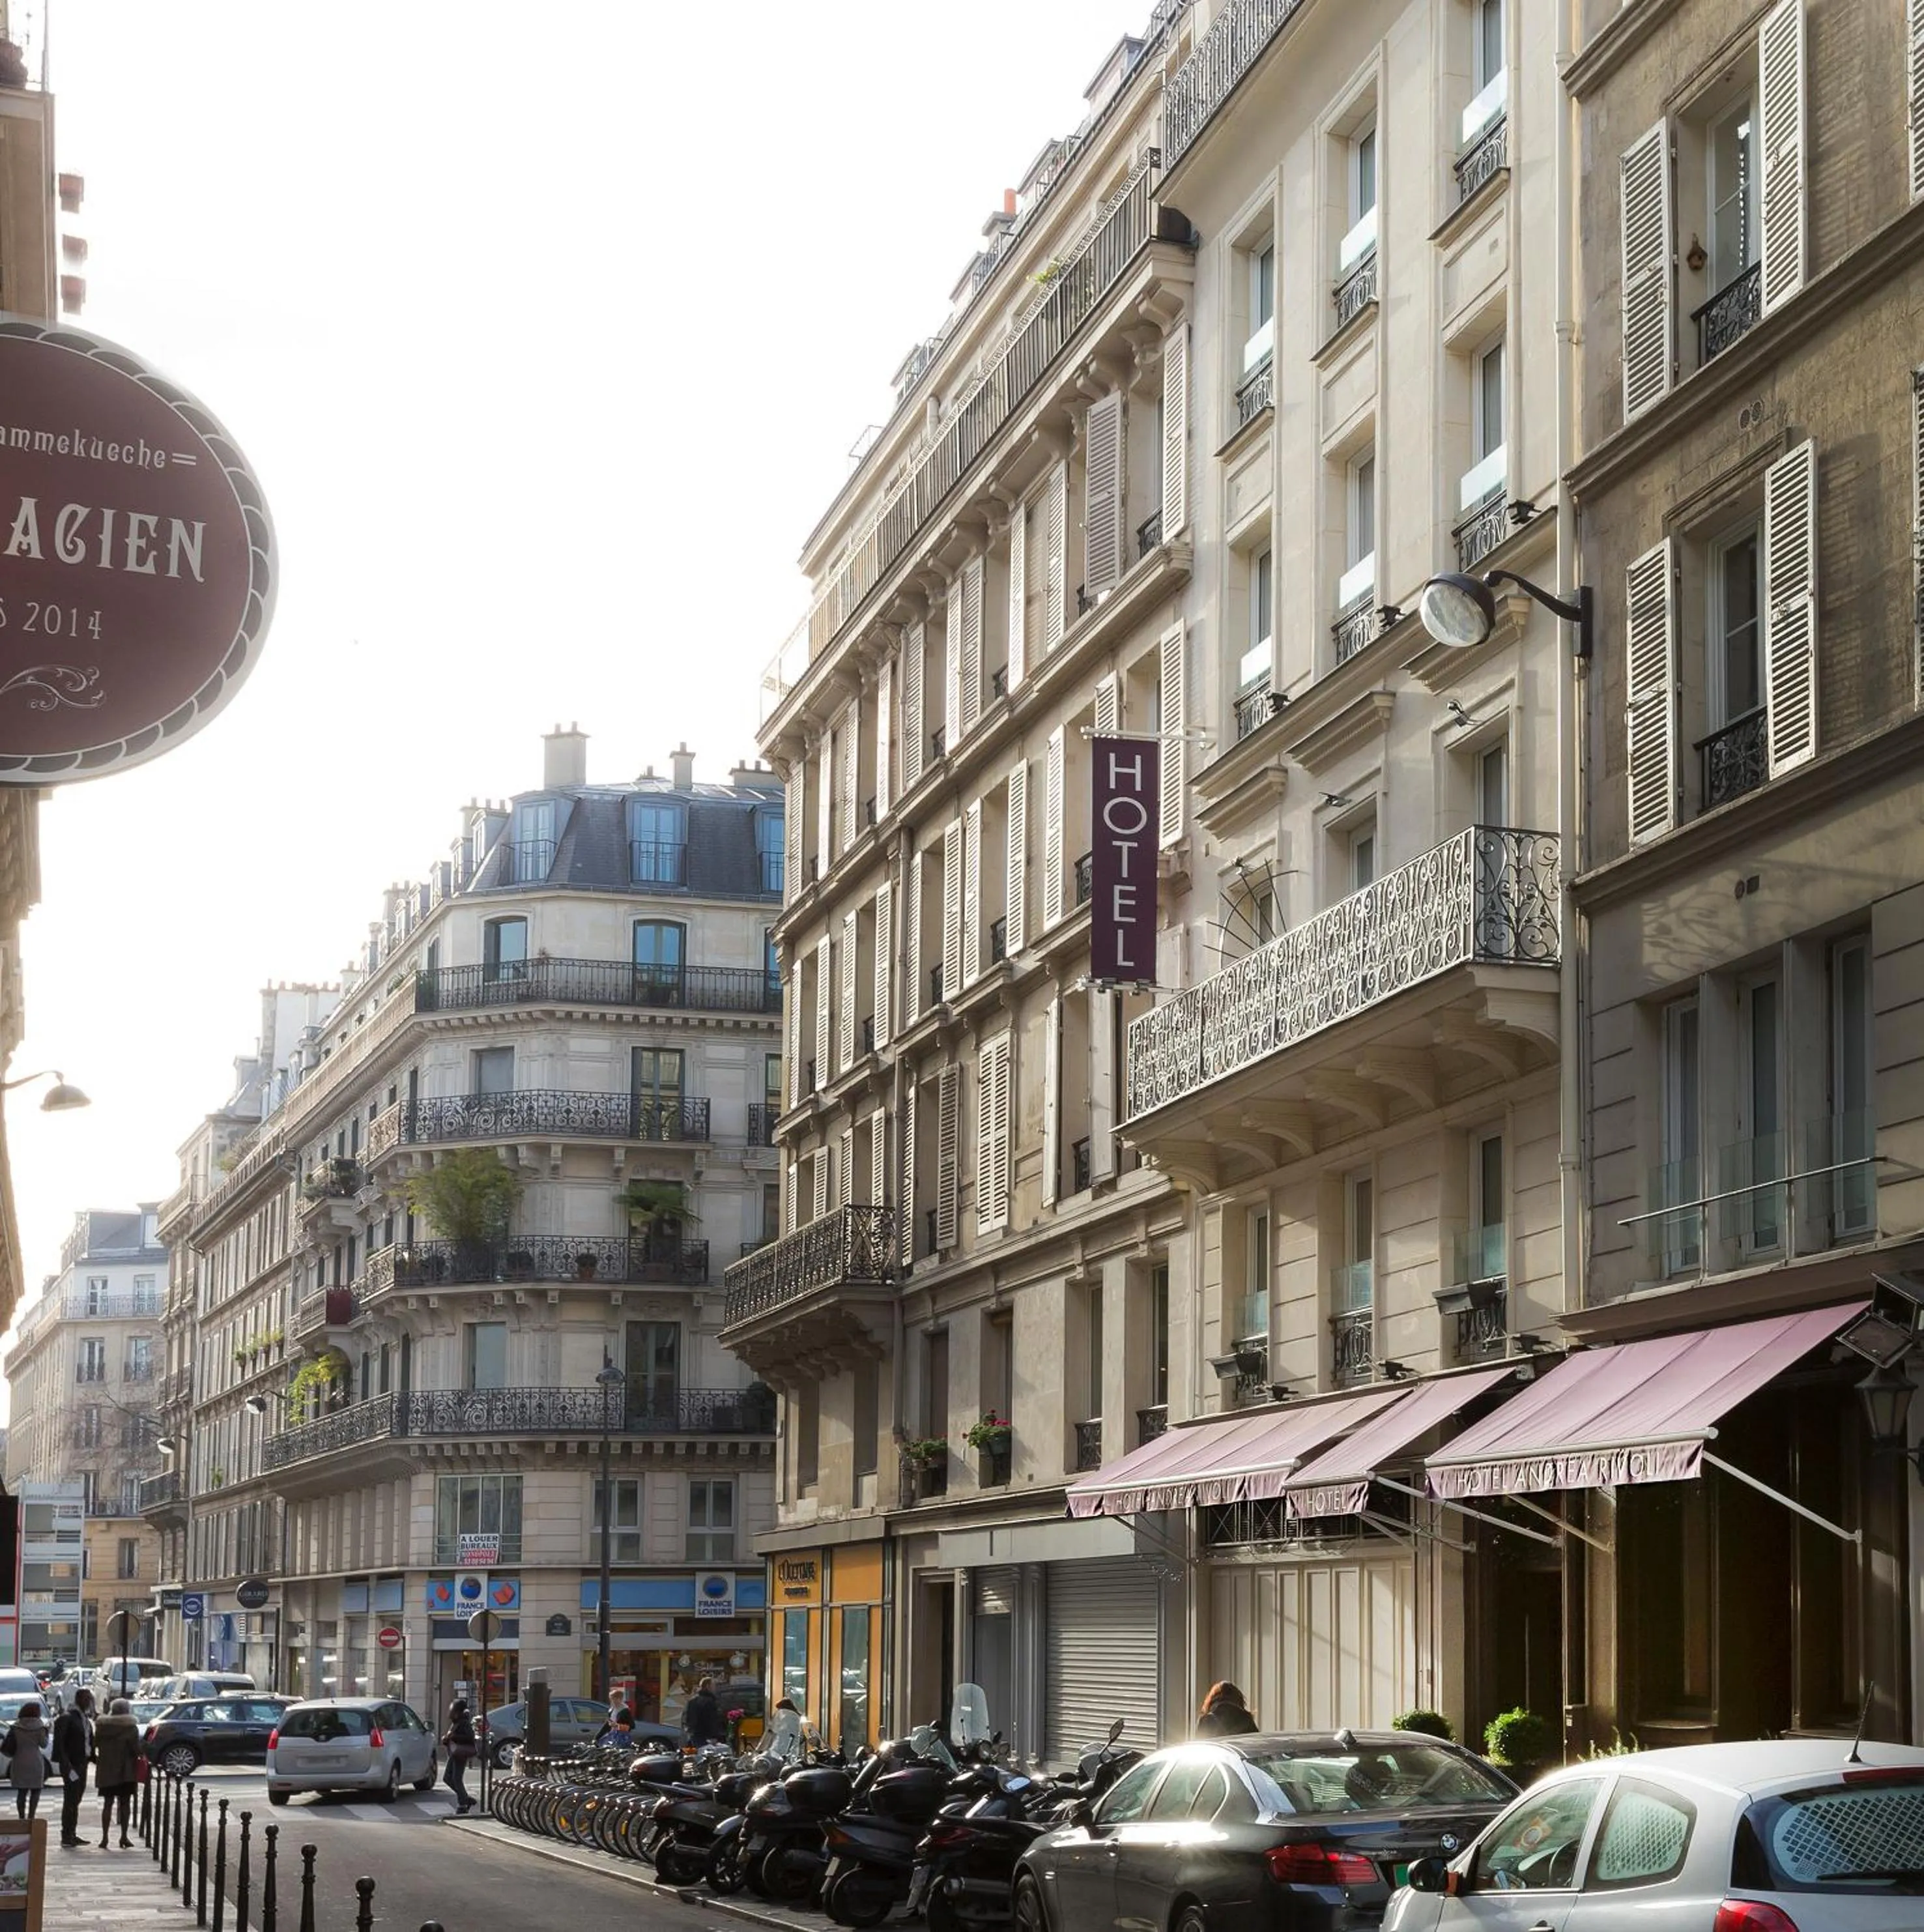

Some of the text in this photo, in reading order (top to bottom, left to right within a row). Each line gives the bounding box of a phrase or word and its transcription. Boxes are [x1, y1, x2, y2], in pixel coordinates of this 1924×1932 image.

[22, 601, 102, 640] 2014
[1102, 752, 1148, 967] HOTEL
[1457, 1450, 1660, 1493] HOTEL ANDREA RIVOLI
[1306, 1490, 1347, 1513] HOTEL
